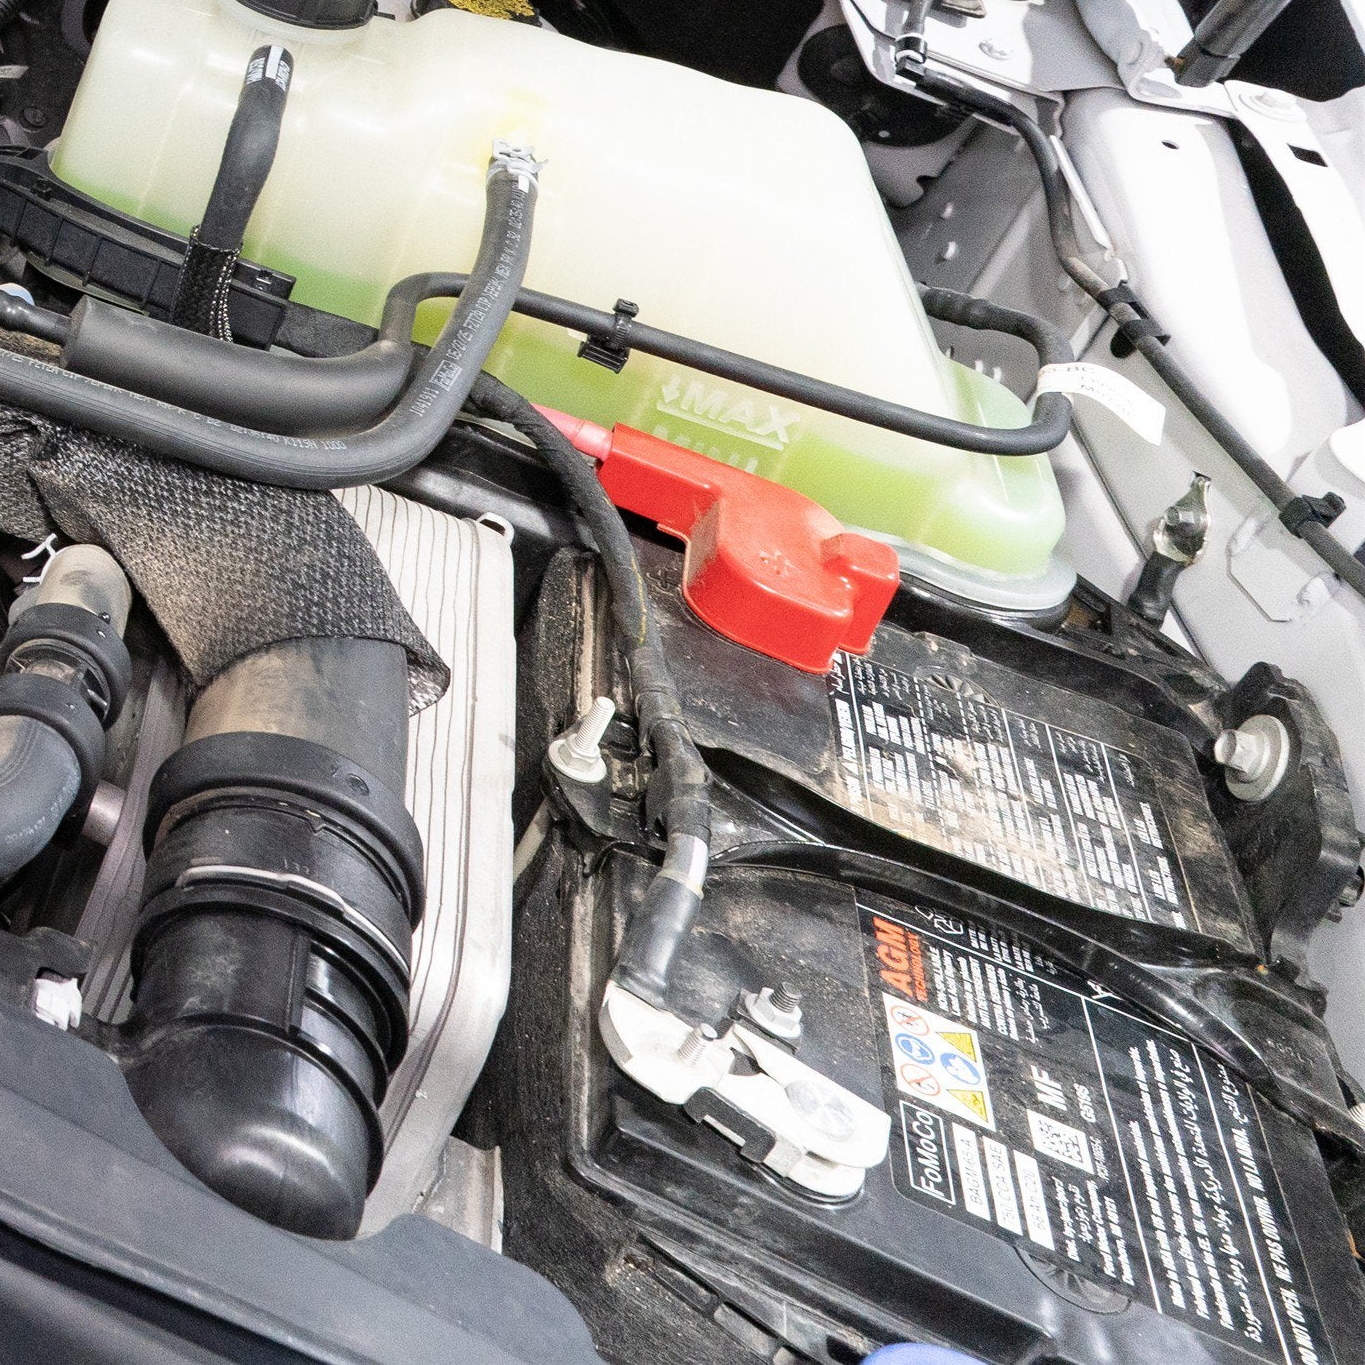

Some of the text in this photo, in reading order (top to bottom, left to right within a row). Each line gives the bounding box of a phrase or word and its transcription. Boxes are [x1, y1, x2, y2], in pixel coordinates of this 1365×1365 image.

[683, 383, 797, 443] MAX
[870, 913, 913, 997] AGM
[907, 930, 928, 1004] TECHNOLOGY
[1030, 1064, 1067, 1112] MF
[909, 1106, 944, 1197] FoMoCo
[959, 1135, 982, 1205] BAGM-65-A
[989, 1143, 1005, 1172] SAE
[1244, 1170, 1264, 1192] NO
[994, 1172, 1011, 1202] CCA
[1100, 1250, 1116, 1278] Ford
[1250, 1190, 1293, 1284] NE PAS OUVRIR.
[1277, 1282, 1321, 1365] DO NOT OPEN.
